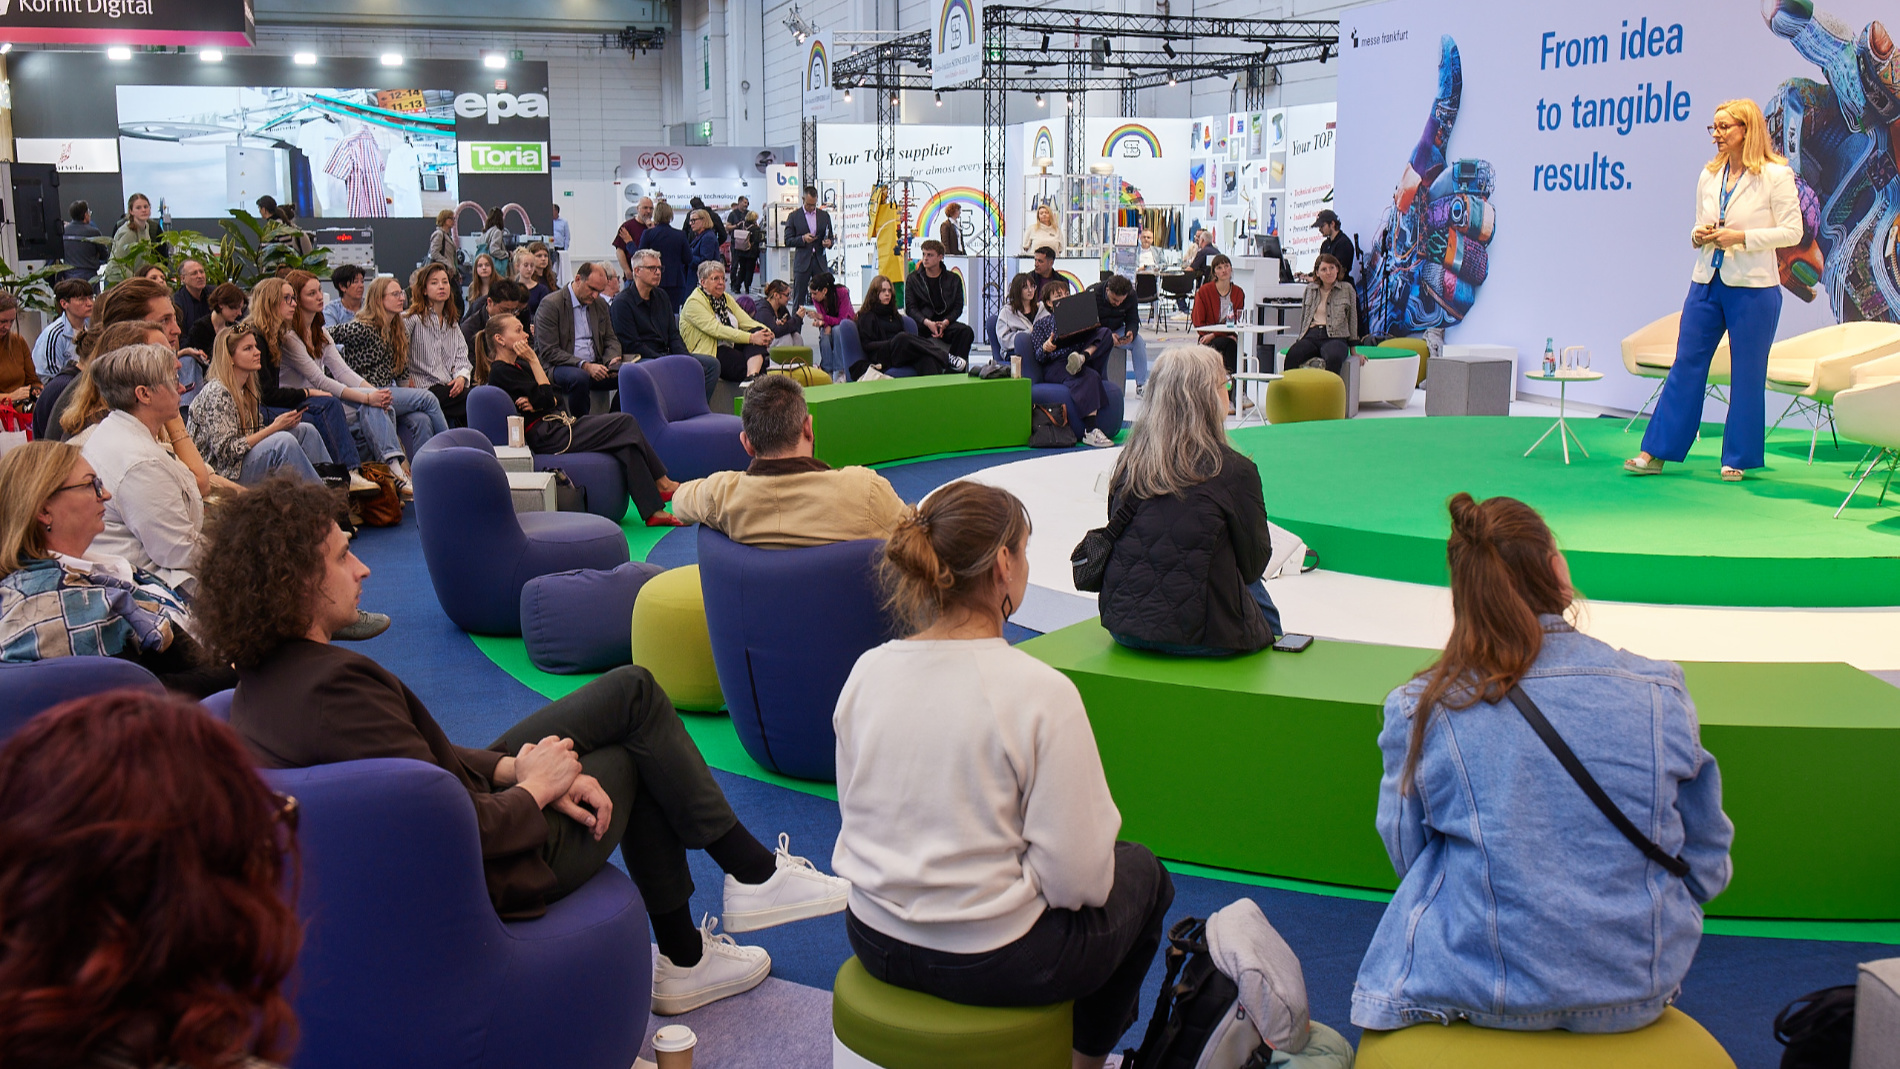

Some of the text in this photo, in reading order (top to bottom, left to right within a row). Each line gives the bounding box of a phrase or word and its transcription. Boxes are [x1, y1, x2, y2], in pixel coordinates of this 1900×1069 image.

[88, 0, 153, 17] Digital
[1361, 30, 1408, 47] messe frankfurt
[1541, 17, 1683, 70] From idea
[390, 90, 420, 100] 12-14
[392, 100, 422, 110] 11-13
[454, 92, 549, 124] epa
[1537, 80, 1690, 135] to tangible
[1293, 131, 1333, 156] Your TOP
[472, 146, 539, 165] Toria
[829, 143, 953, 166] Your TOP supplier
[910, 168, 923, 177] for
[925, 164, 956, 175] almost
[958, 162, 982, 173] every
[1533, 151, 1632, 191] results.
